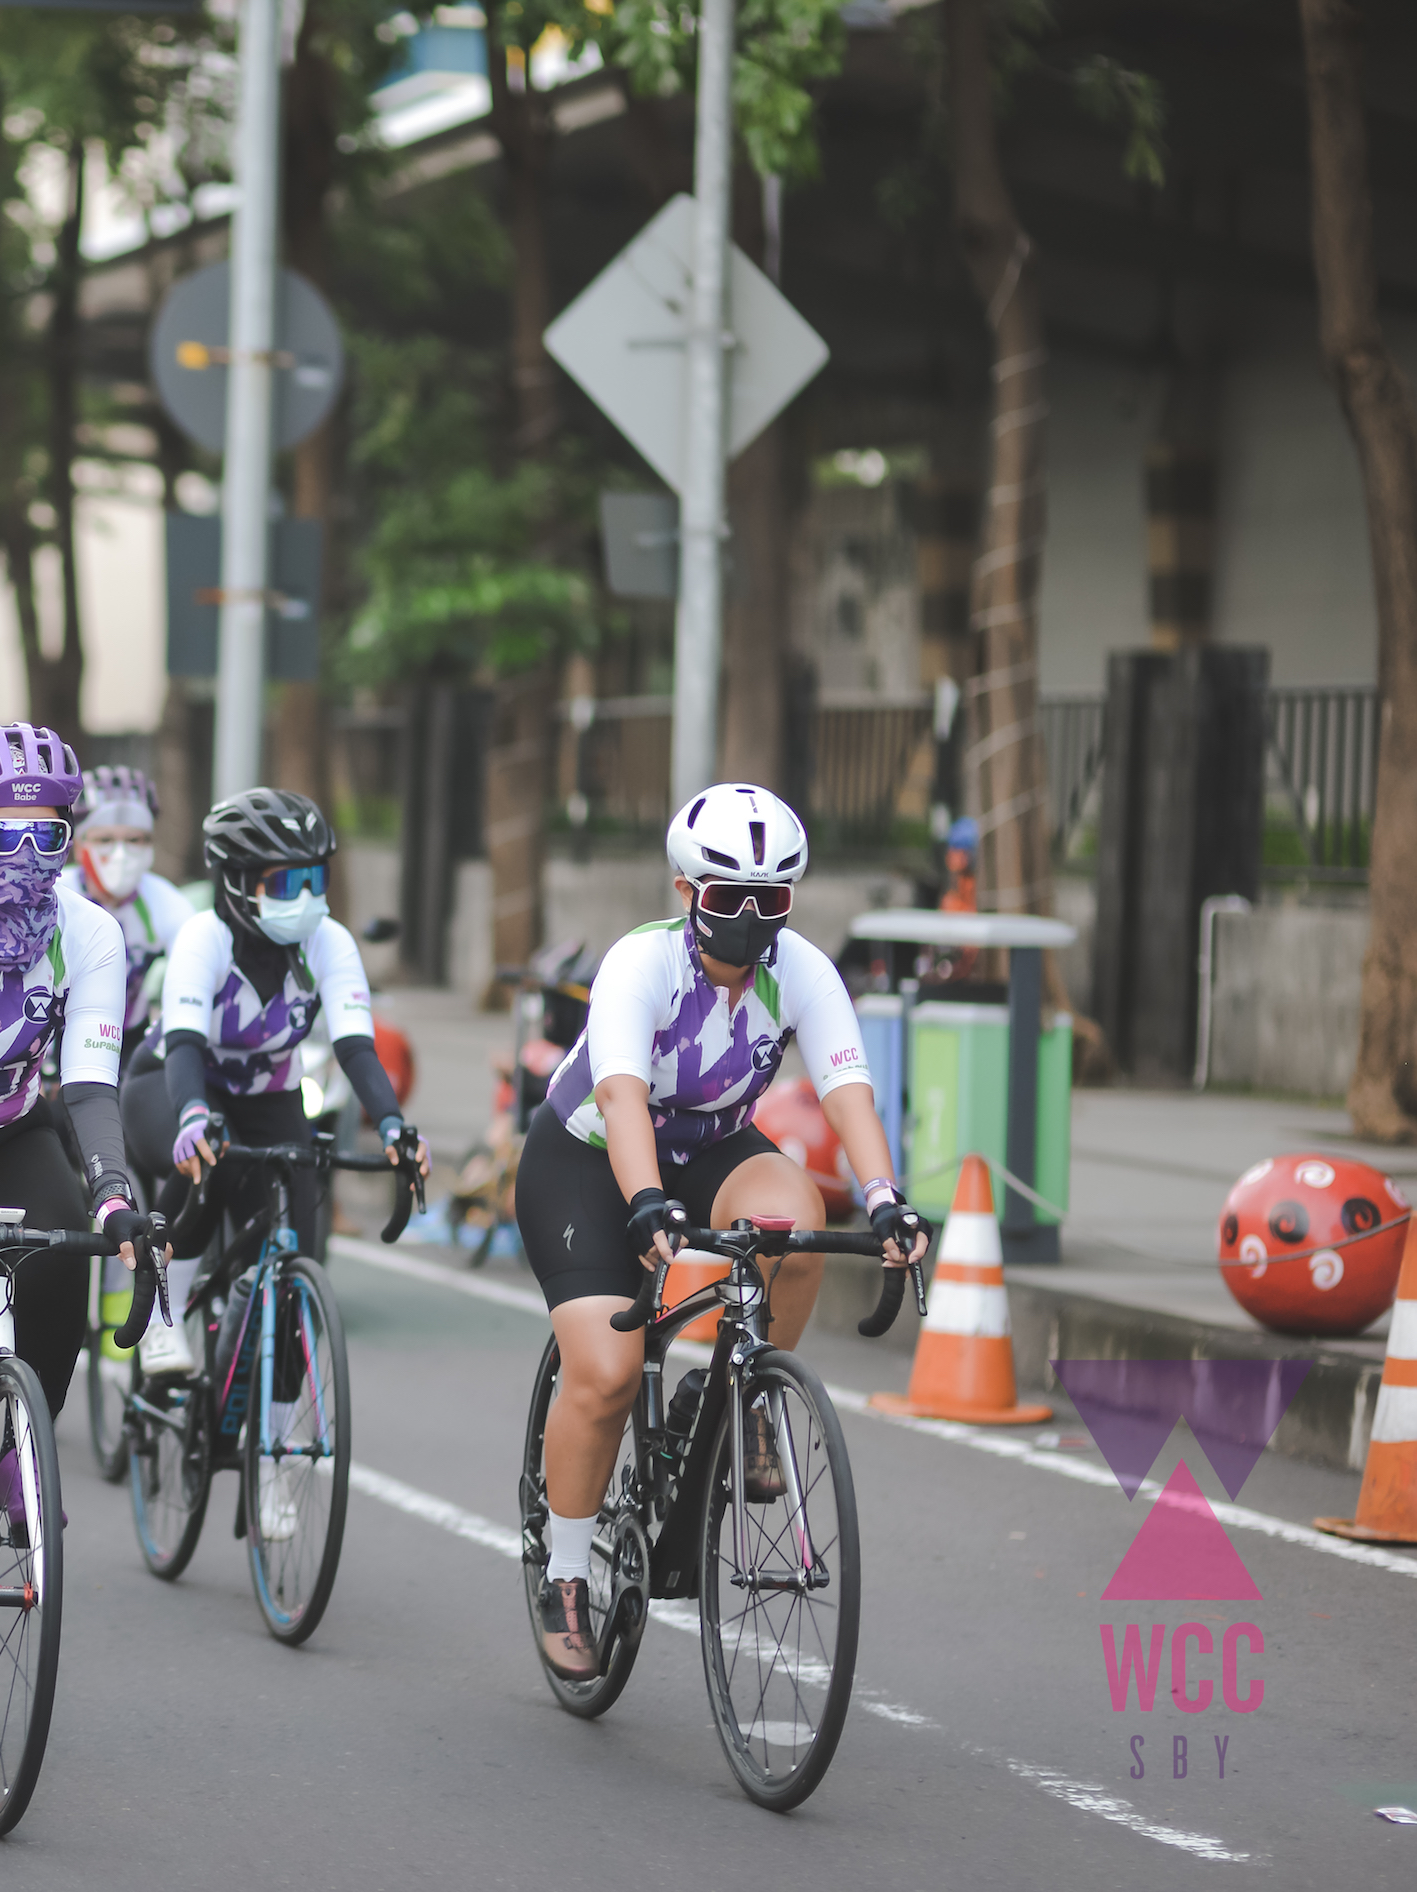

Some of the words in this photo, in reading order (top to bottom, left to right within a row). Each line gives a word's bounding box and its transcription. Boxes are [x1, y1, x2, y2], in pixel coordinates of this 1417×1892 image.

[11, 783, 42, 793] WCC
[14, 793, 37, 801] Babe
[829, 1047, 859, 1067] WCC
